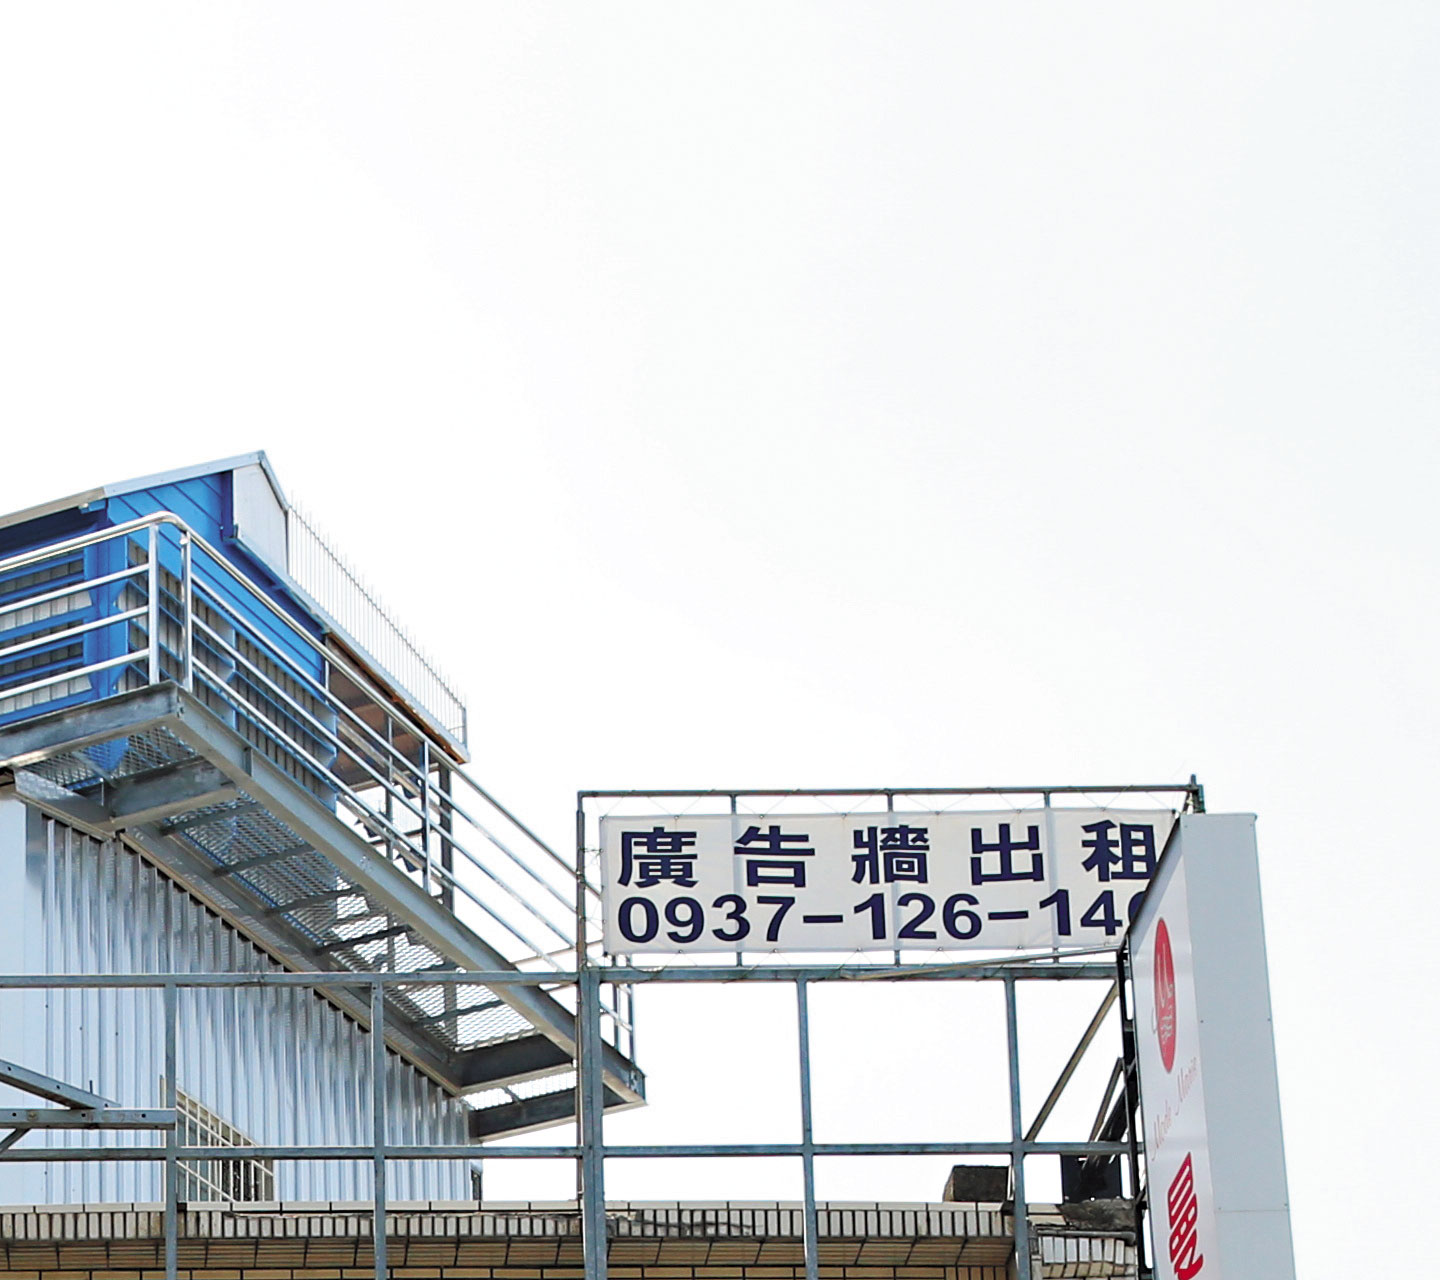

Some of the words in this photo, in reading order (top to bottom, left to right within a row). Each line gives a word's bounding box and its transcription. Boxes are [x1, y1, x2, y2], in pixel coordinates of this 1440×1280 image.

[618, 819, 1160, 889] 廣告牆出租
